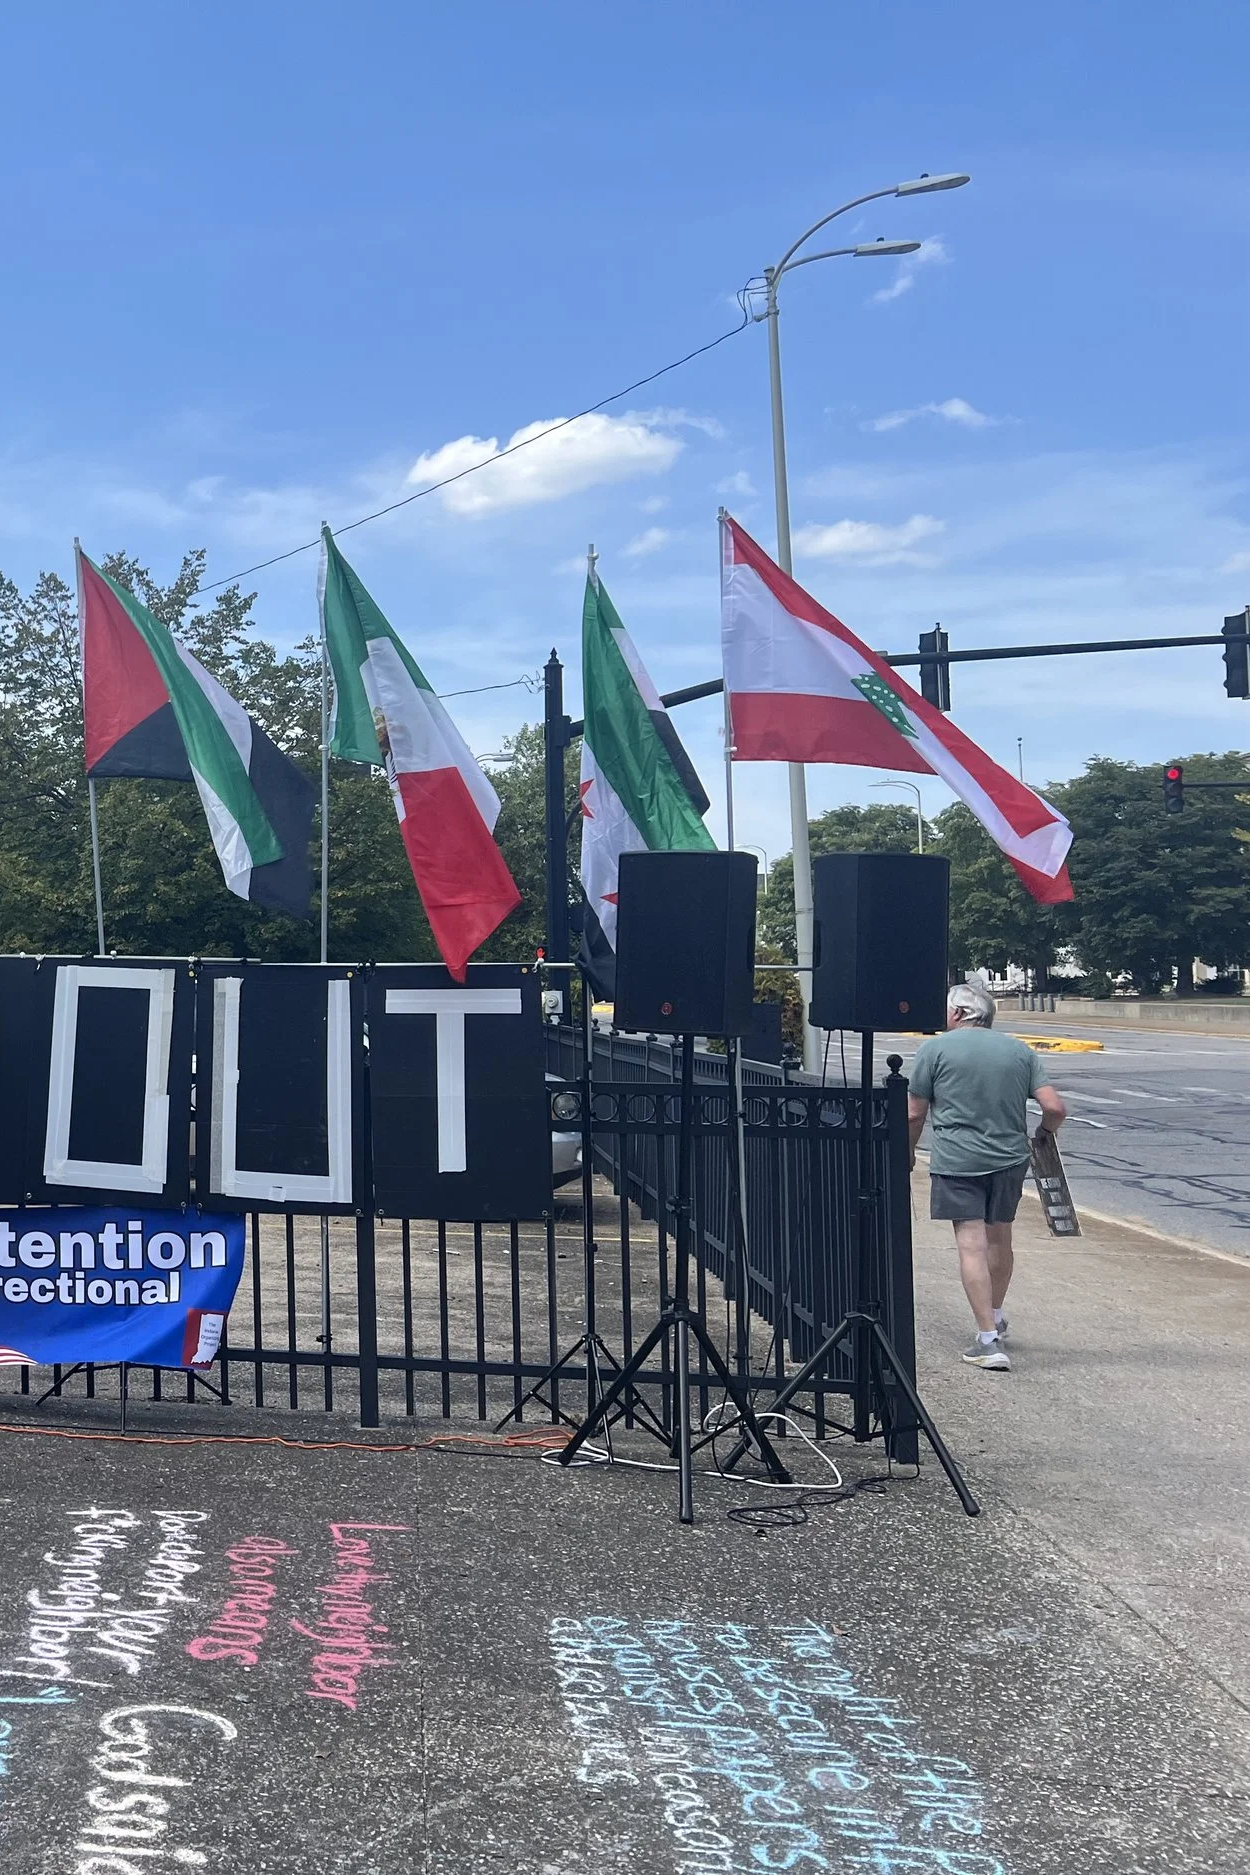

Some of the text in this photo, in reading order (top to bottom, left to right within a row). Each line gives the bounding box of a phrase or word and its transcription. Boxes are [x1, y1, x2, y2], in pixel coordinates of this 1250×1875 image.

[43, 965, 522, 1203] OUT
[184, 1536, 302, 1667] also means
[330, 1522, 417, 1567] Love
[291, 1600, 400, 1709] neighbor
[89, 1704, 238, 1787] God
[705, 1621, 759, 1650] to
[751, 1687, 870, 1791] secure
[822, 1804, 898, 1840] in
[769, 1617, 834, 1657] The
[890, 1769, 986, 1836] the
[637, 1727, 735, 1875] unreason
